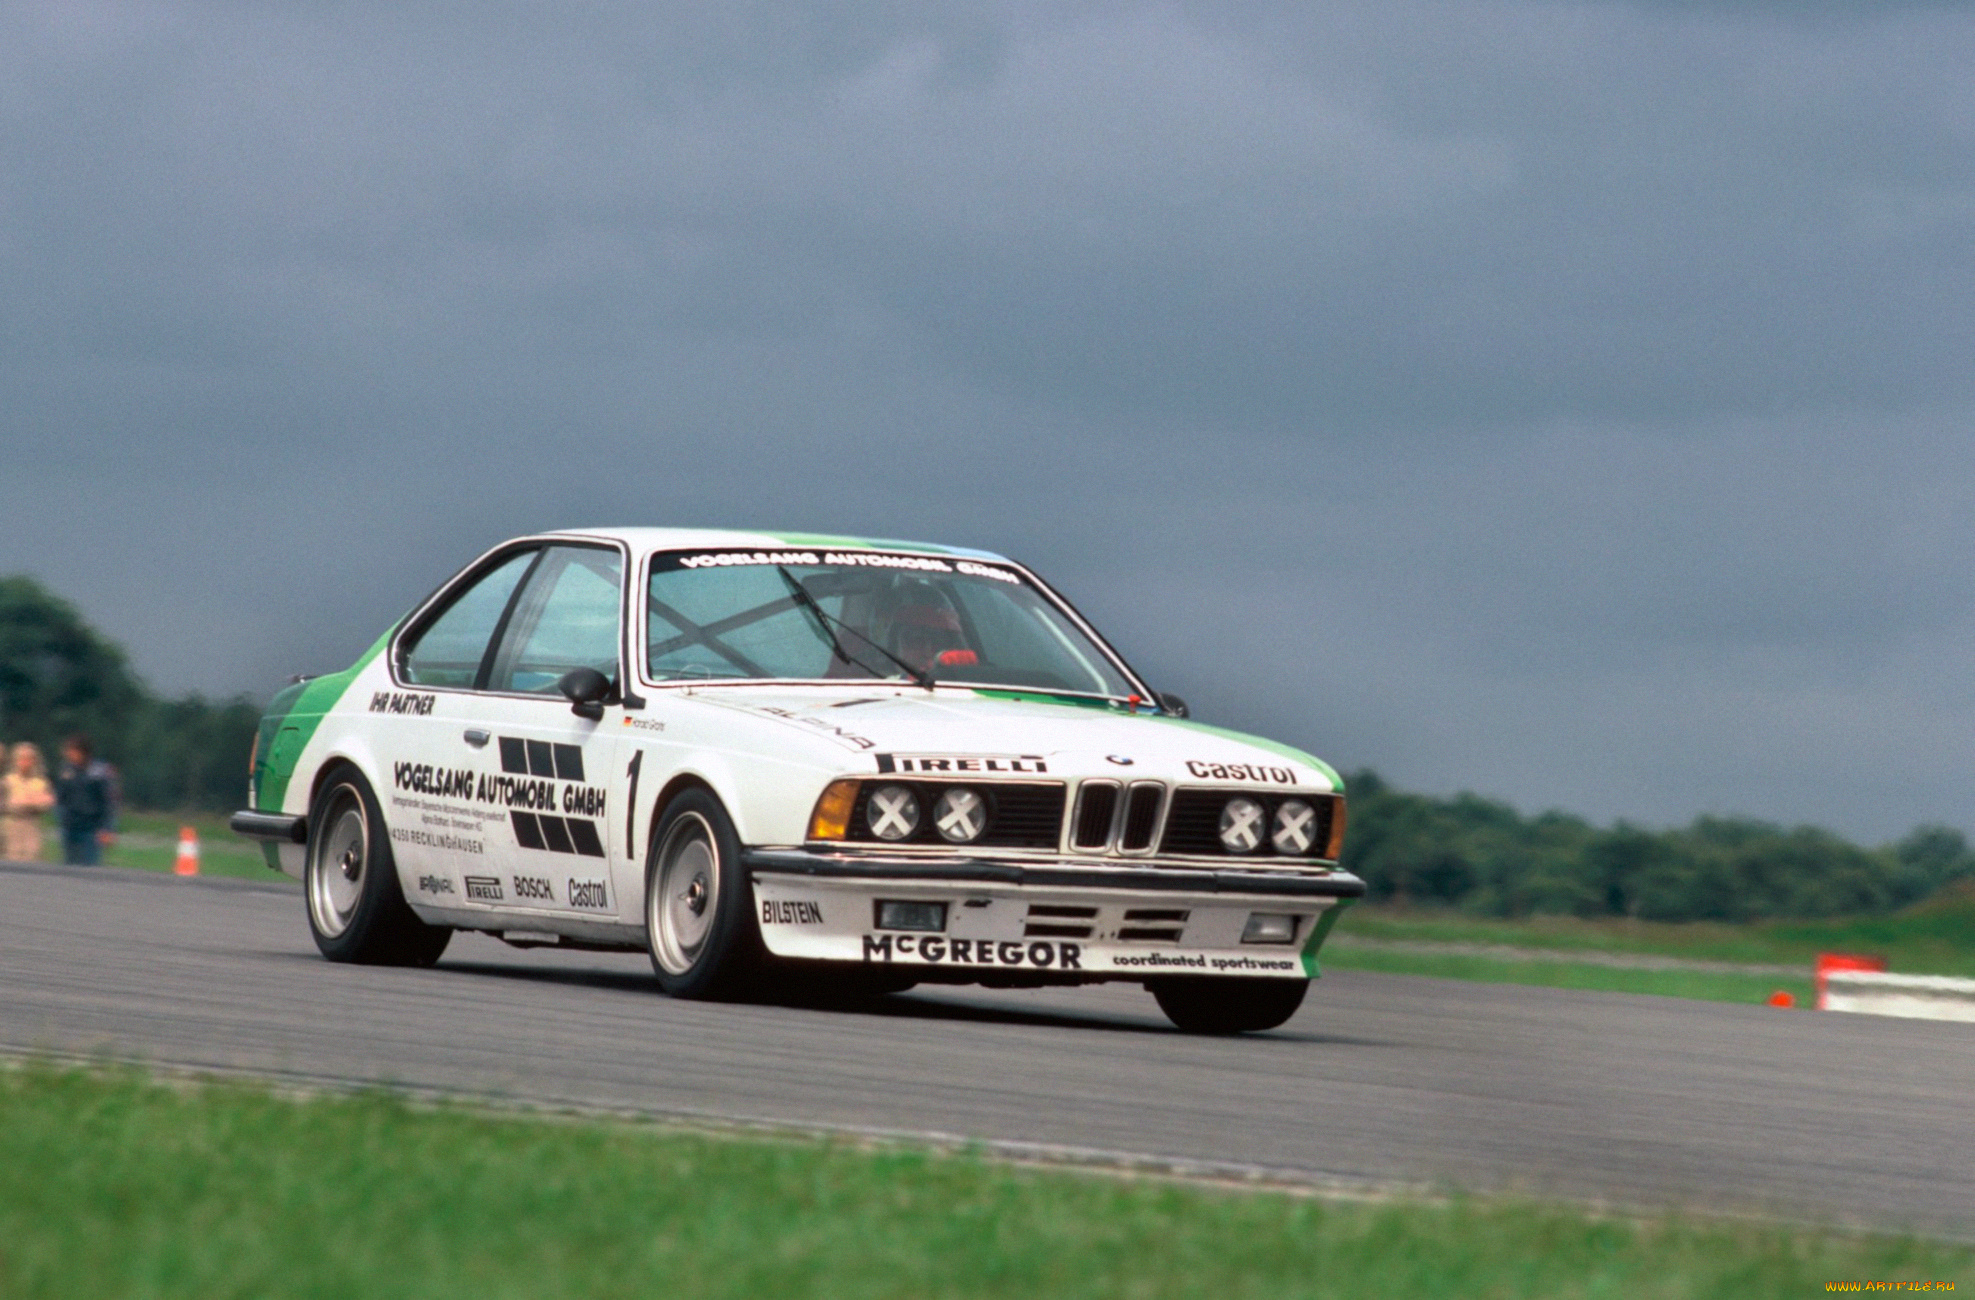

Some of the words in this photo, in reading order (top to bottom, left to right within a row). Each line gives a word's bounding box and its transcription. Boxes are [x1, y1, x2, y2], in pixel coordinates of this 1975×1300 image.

[680, 552, 820, 569] VOGELSANG
[824, 553, 953, 573] AUTOMOBIL
[369, 691, 390, 713] IHR
[387, 692, 436, 716] PARTNER
[874, 753, 1048, 774] PIRELLI
[1185, 760, 1298, 785] Castrol
[394, 760, 474, 800] VOGELSANG
[476, 772, 557, 811] AUTOMOBIL
[563, 782, 606, 817] GMBH
[626, 749, 644, 861] 1
[410, 829, 484, 855] RECKLINGHAUSEN
[464, 876, 504, 900] PIRELLI
[513, 875, 555, 902] BOSCH
[568, 877, 608, 909] Castrol
[763, 901, 824, 924] BILSTEIN
[1112, 953, 1206, 967] coordinated
[1211, 956, 1295, 972] sportswear
